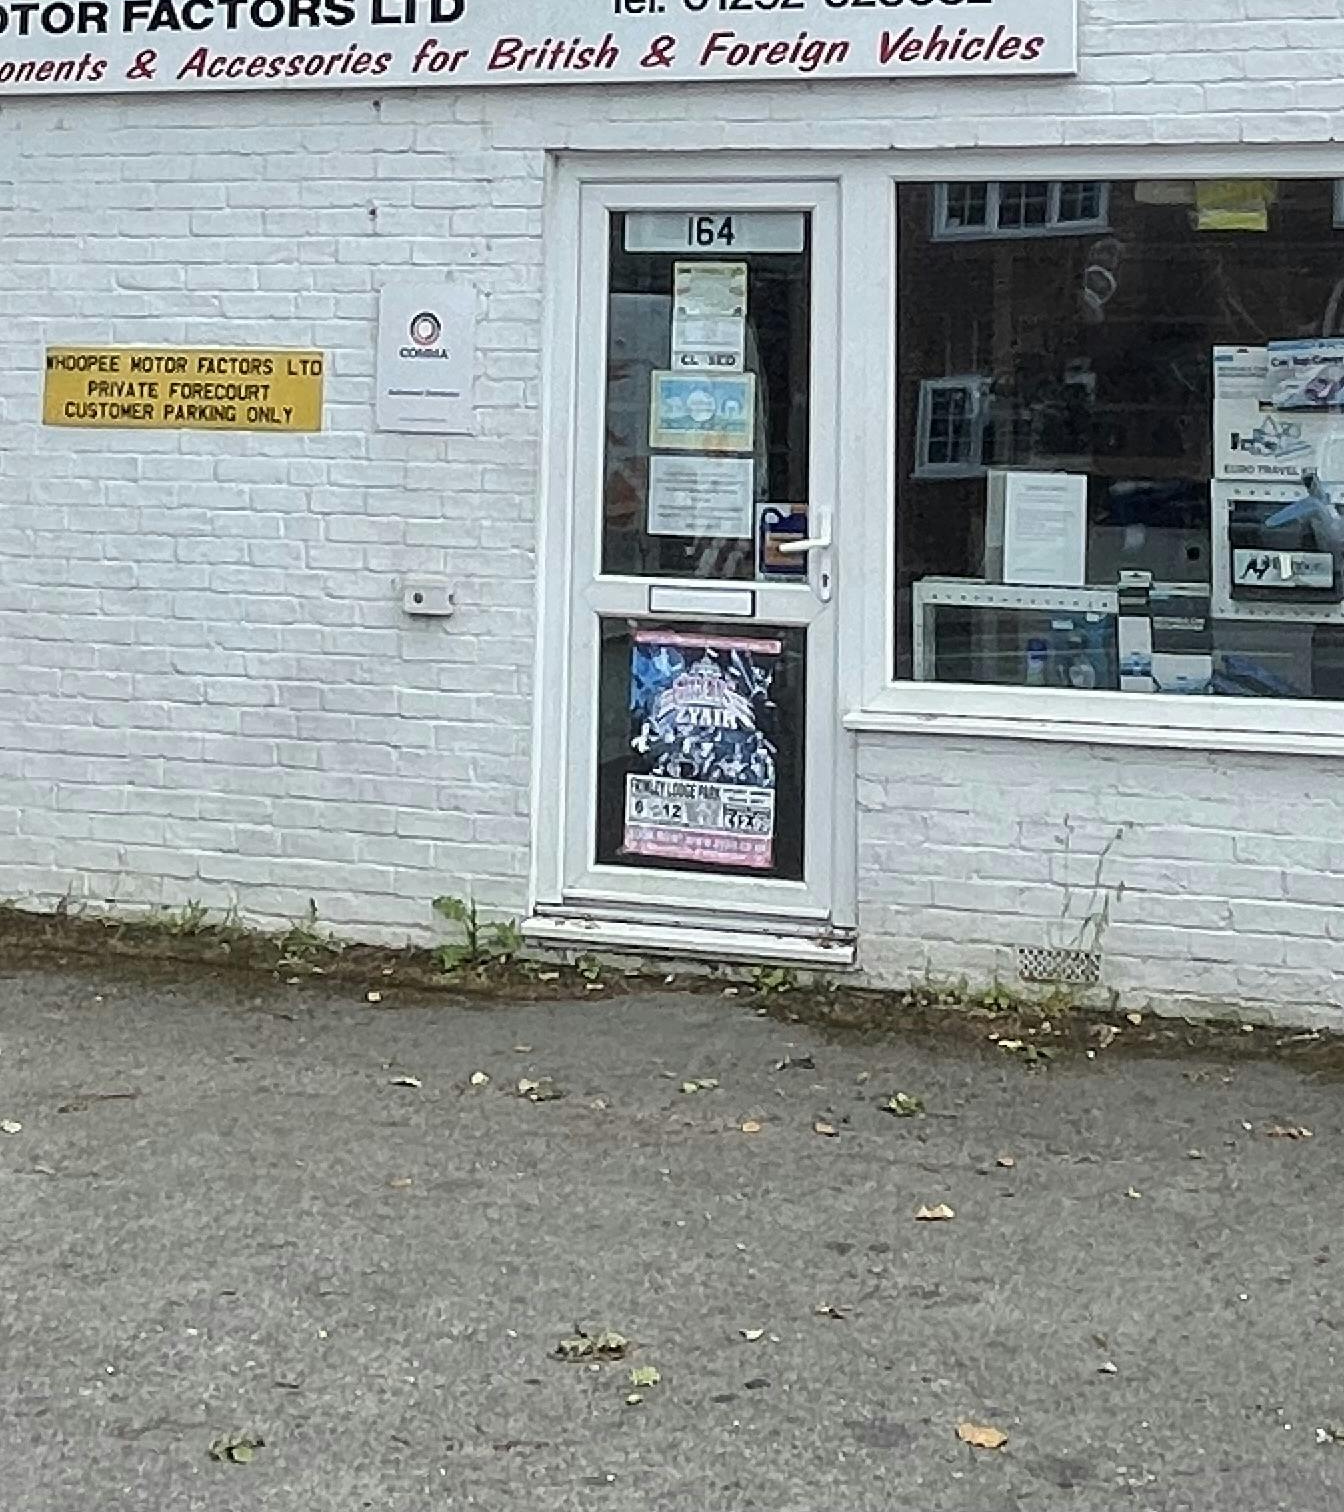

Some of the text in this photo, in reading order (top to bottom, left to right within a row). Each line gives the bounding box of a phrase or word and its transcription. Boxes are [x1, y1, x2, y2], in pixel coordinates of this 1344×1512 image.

[126, 48, 157, 80] &
[177, 42, 391, 80] Accessories
[412, 38, 469, 73] for
[488, 33, 619, 71] British
[640, 35, 676, 68] &
[699, 30, 850, 71] Foreign
[878, 24, 1046, 65] Vehicles
[688, 216, 736, 247] 164
[46, 353, 322, 377] WHOOPEE MOTOR FACTORS LTD
[87, 380, 271, 402] PRIVATE FORECOURT
[64, 402, 293, 425] CUSTOMER PARKING ONLY
